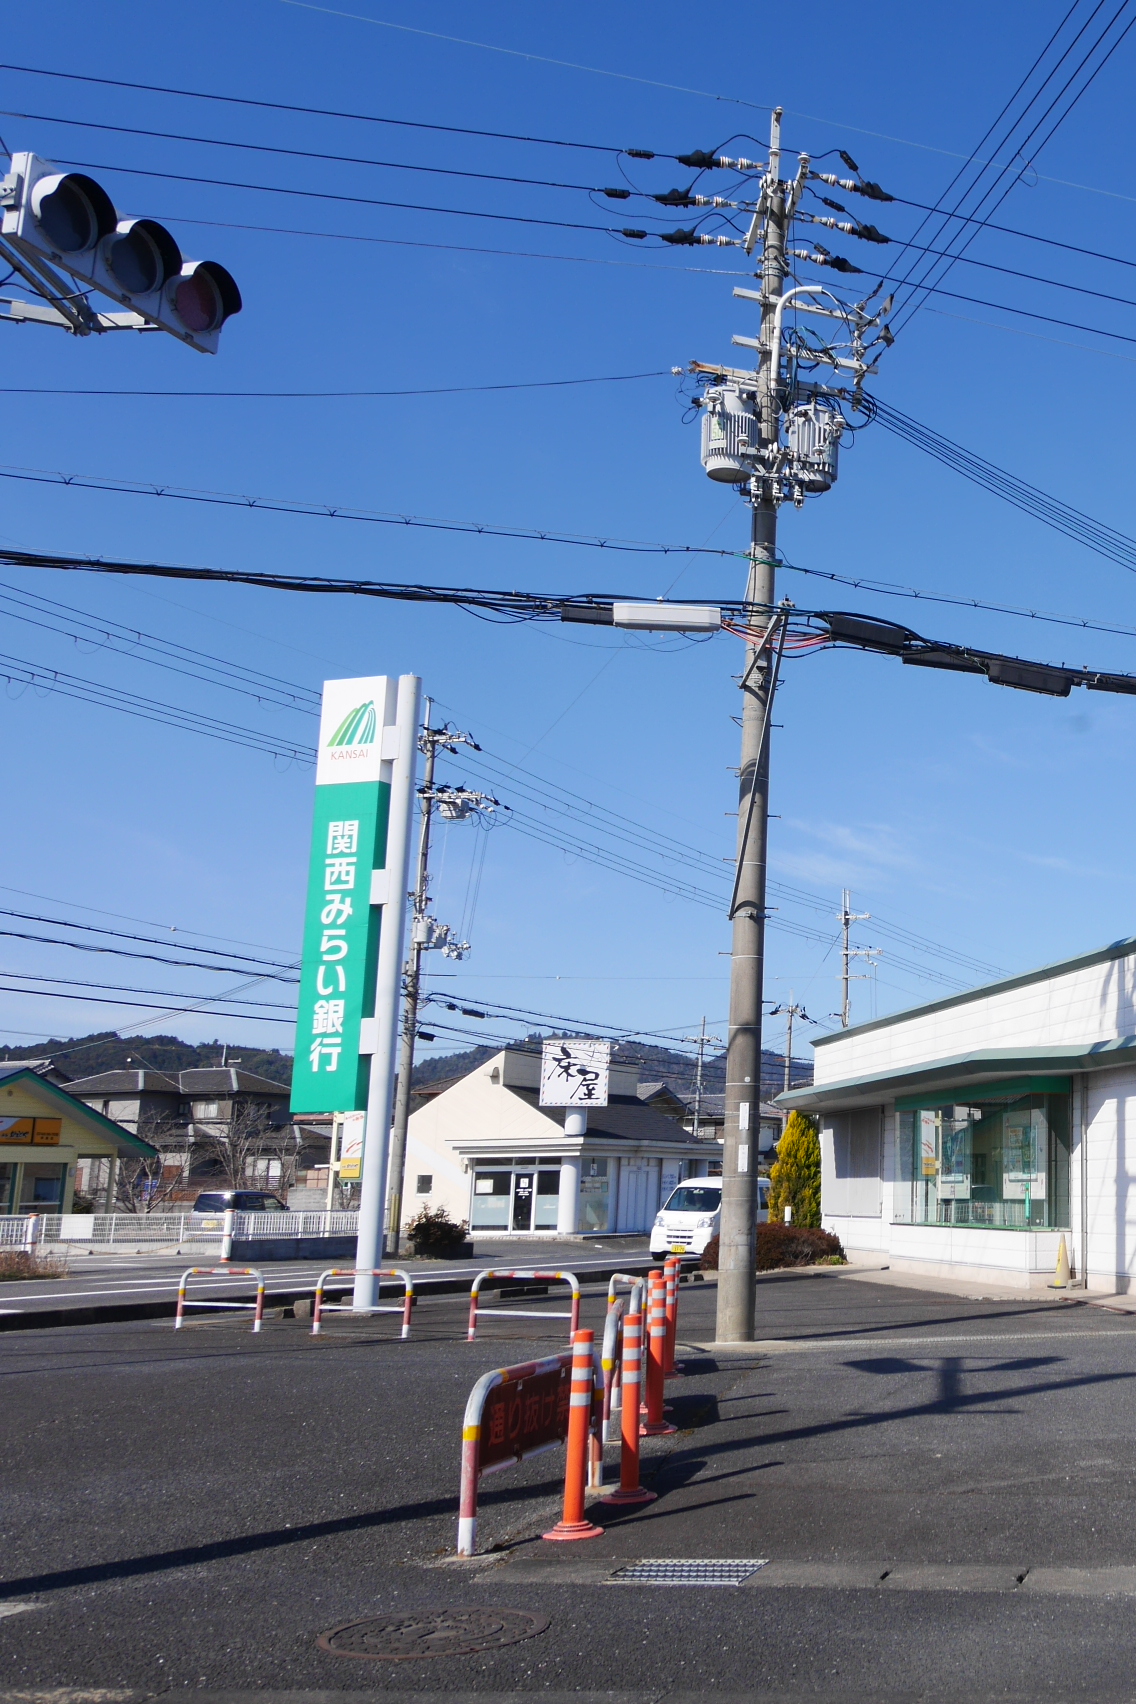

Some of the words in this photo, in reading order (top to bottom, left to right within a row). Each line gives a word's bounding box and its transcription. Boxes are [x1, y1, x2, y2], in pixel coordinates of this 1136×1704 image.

[331, 749, 369, 760] KANSAI
[309, 820, 359, 1072] 関西みらい銀行
[547, 1046, 601, 1100] 床屋
